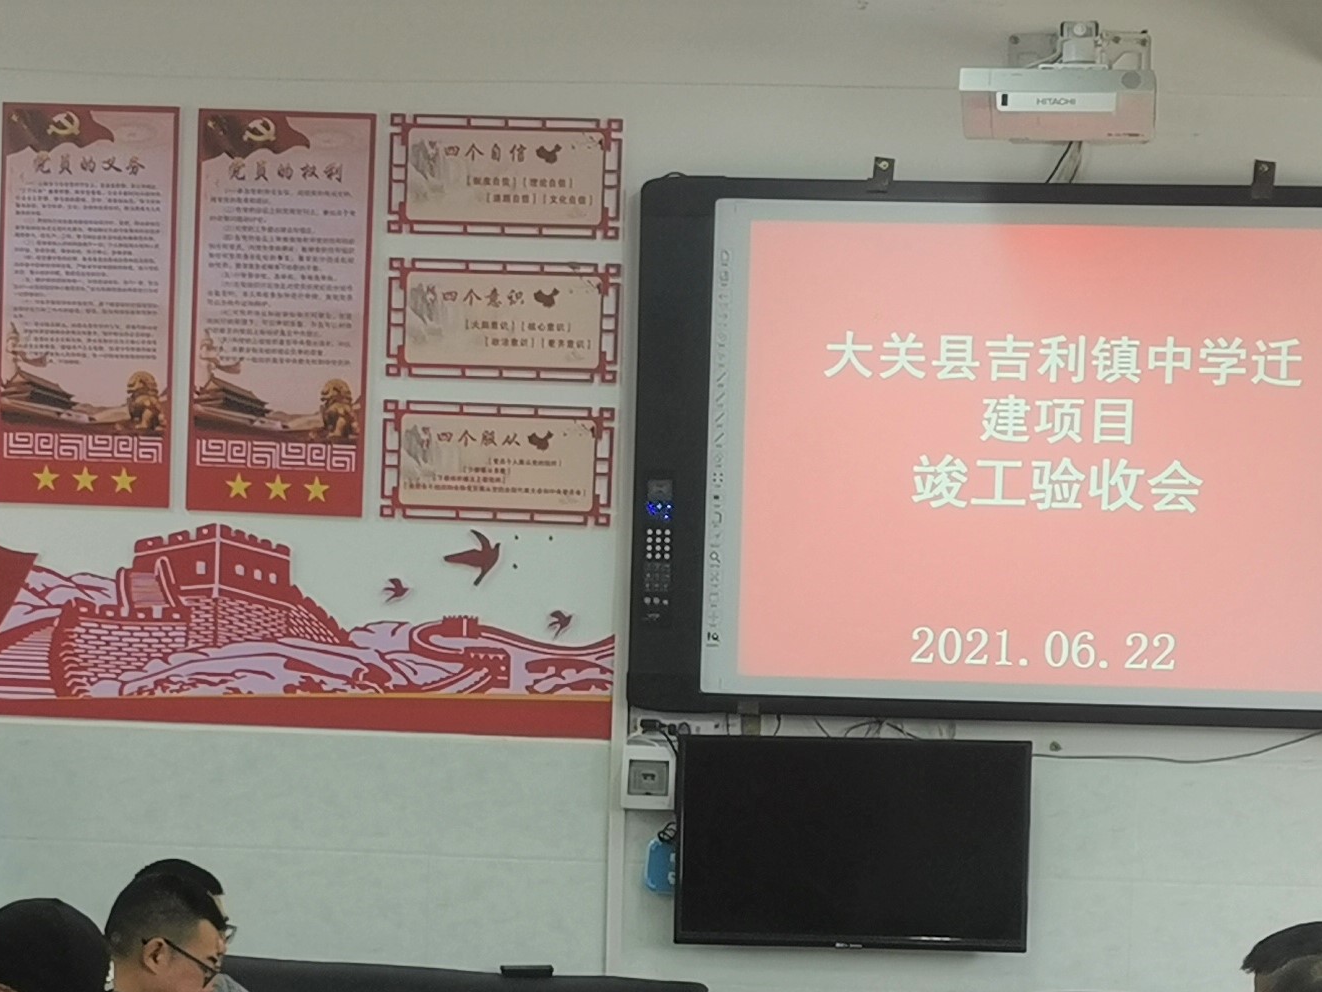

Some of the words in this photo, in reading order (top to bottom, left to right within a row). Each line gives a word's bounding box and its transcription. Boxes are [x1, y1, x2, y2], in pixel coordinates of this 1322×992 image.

[1036, 97, 1076, 106] HITACHI
[32, 150, 146, 177] 党员的义务
[443, 143, 527, 162] 四个自信
[227, 157, 344, 184] 党员的权利
[442, 287, 525, 309] 四个意识
[823, 330, 1303, 388] 大关县吉利镇中学迁
[980, 394, 1135, 446] 建项目
[910, 453, 1204, 514] 竣工验收会
[909, 626, 1177, 671] 2021.06.22
